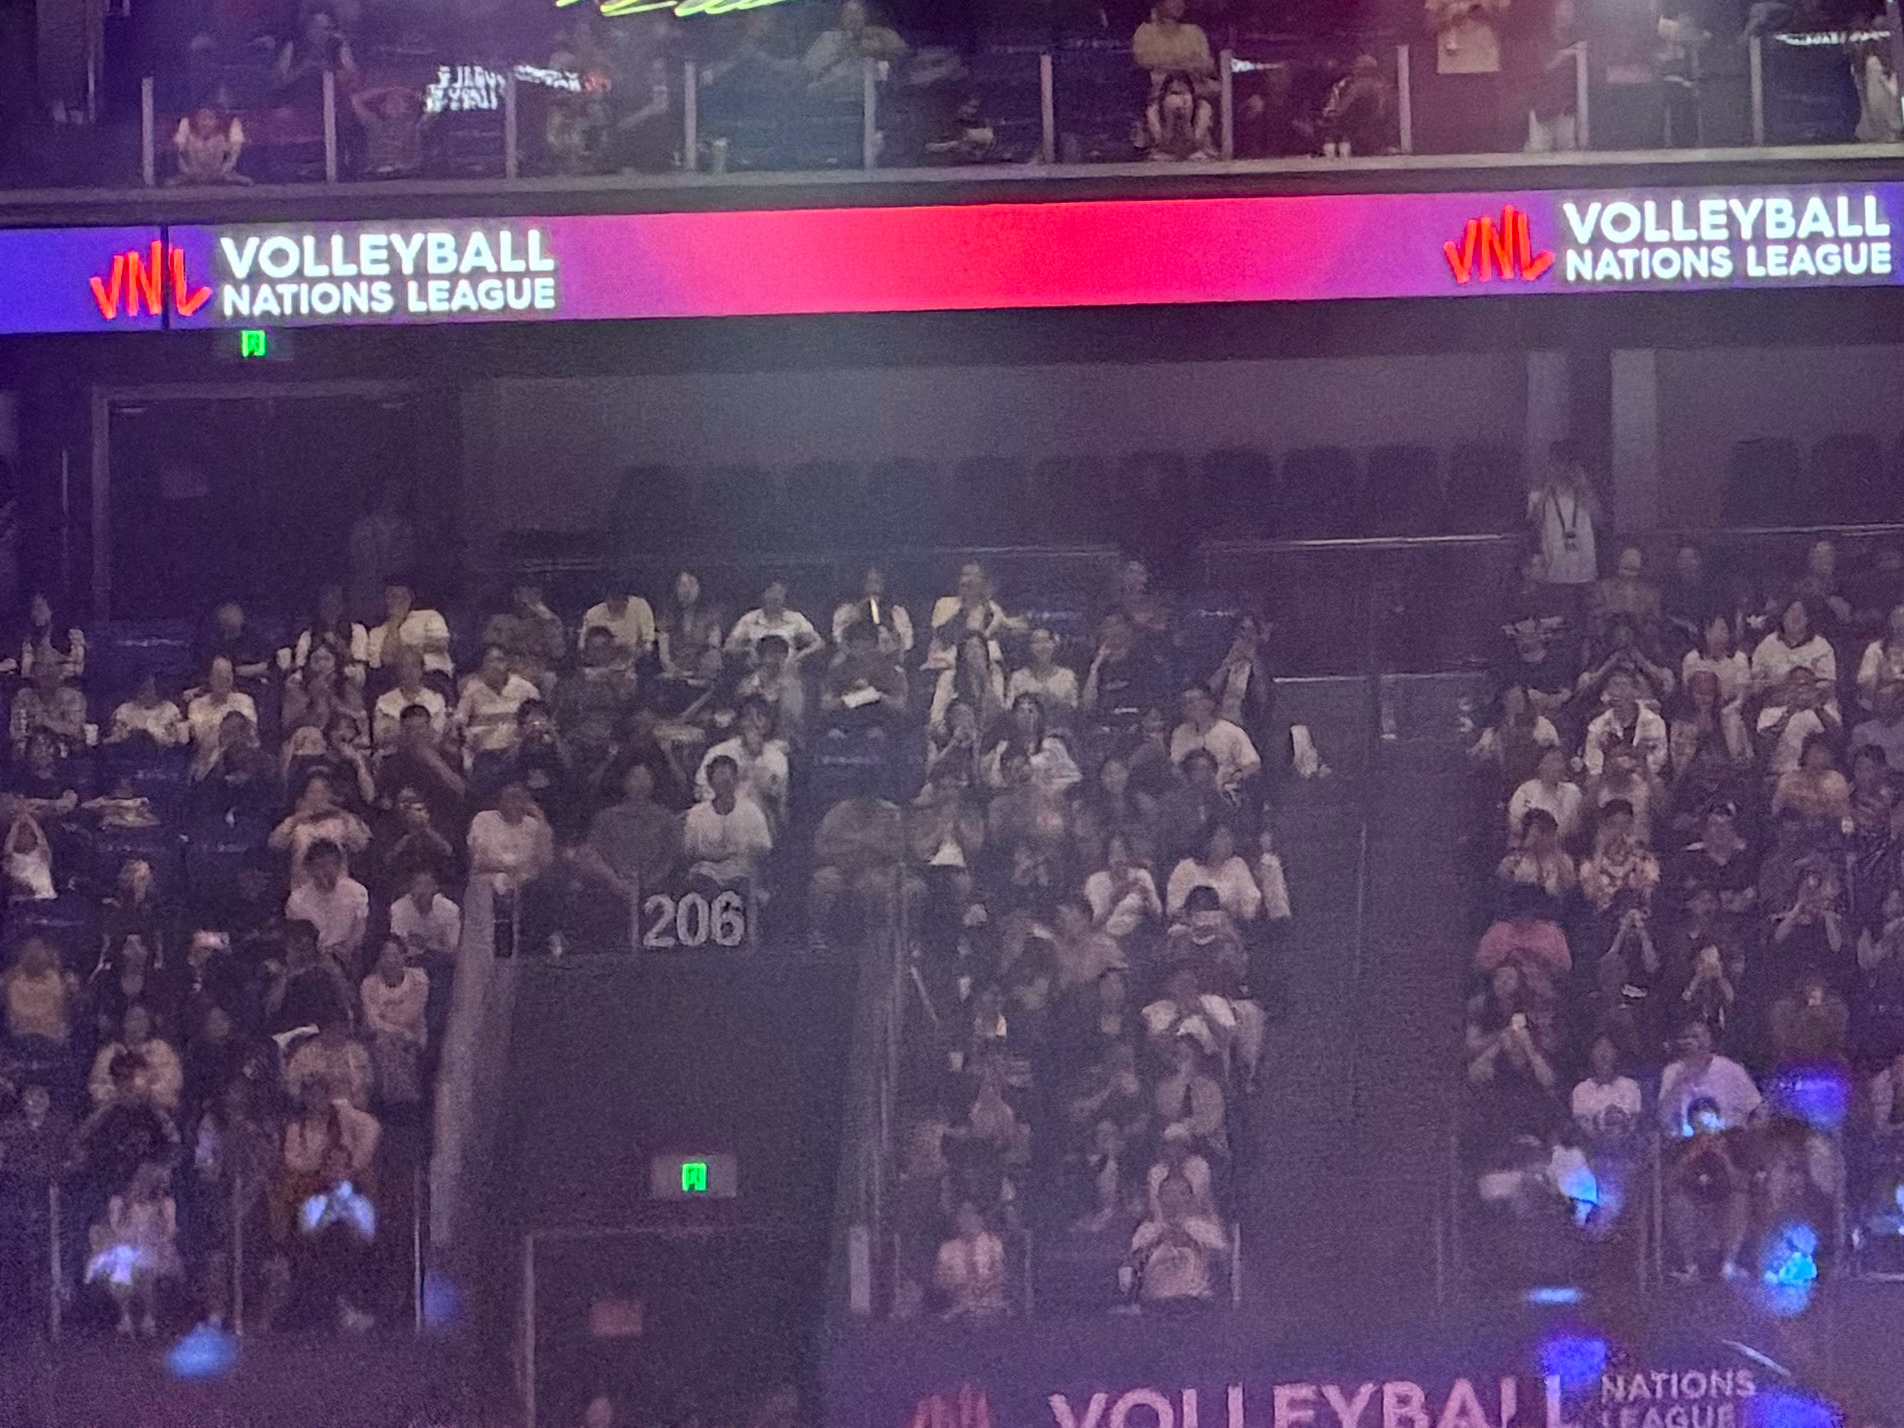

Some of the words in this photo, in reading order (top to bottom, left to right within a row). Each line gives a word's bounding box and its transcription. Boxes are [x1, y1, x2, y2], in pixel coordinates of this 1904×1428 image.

[1563, 195, 1891, 244] VOLLEYBALL
[220, 229, 555, 279] VOLLEYBALL
[1566, 246, 1733, 282] NATIONS
[1747, 242, 1892, 276] LEAGUE
[223, 281, 394, 316] NATIONS
[407, 277, 555, 312] LEAGUE
[643, 891, 745, 947] 206
[1601, 1369, 1757, 1402] NATIONS
